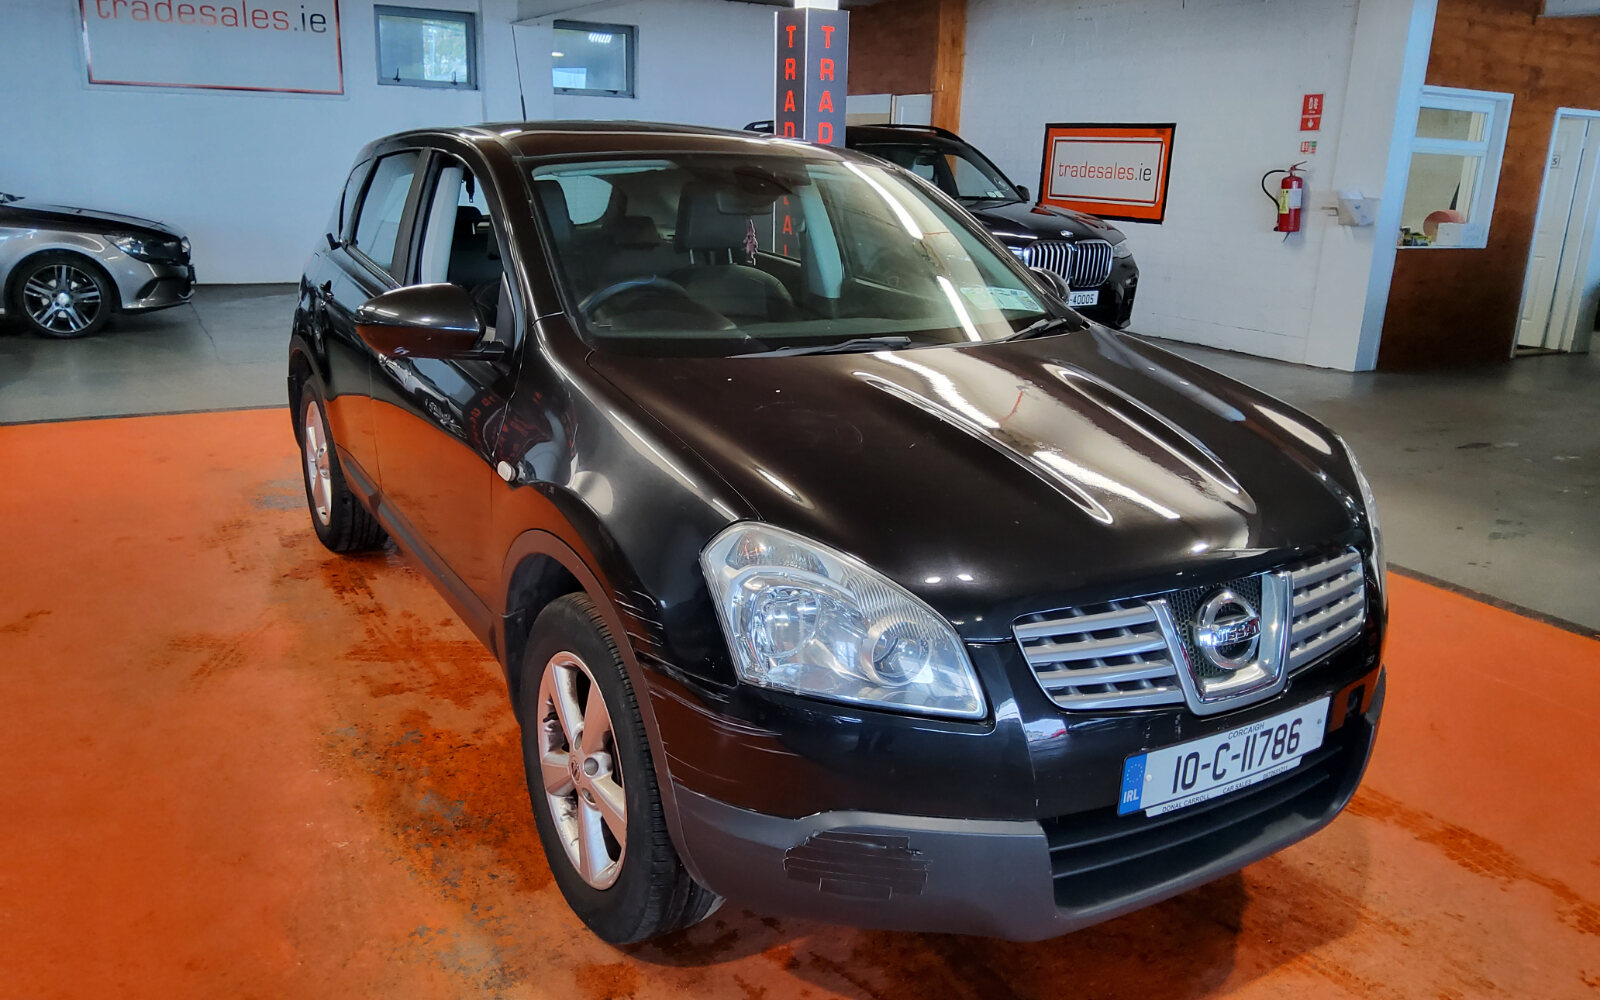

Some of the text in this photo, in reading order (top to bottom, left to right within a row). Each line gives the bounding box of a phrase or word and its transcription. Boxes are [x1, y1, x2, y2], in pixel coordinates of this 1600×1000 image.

[96, 0, 327, 33] tradesales.ie
[1058, 160, 1152, 181] tradesales.ie
[1210, 617, 1260, 645] NISSAN
[1227, 722, 1265, 740] CORCAIGH
[1172, 718, 1303, 794] 10-C-11786
[1123, 789, 1140, 804] IRL
[1162, 779, 1252, 813] DONAL CARROLL CAR SALES
